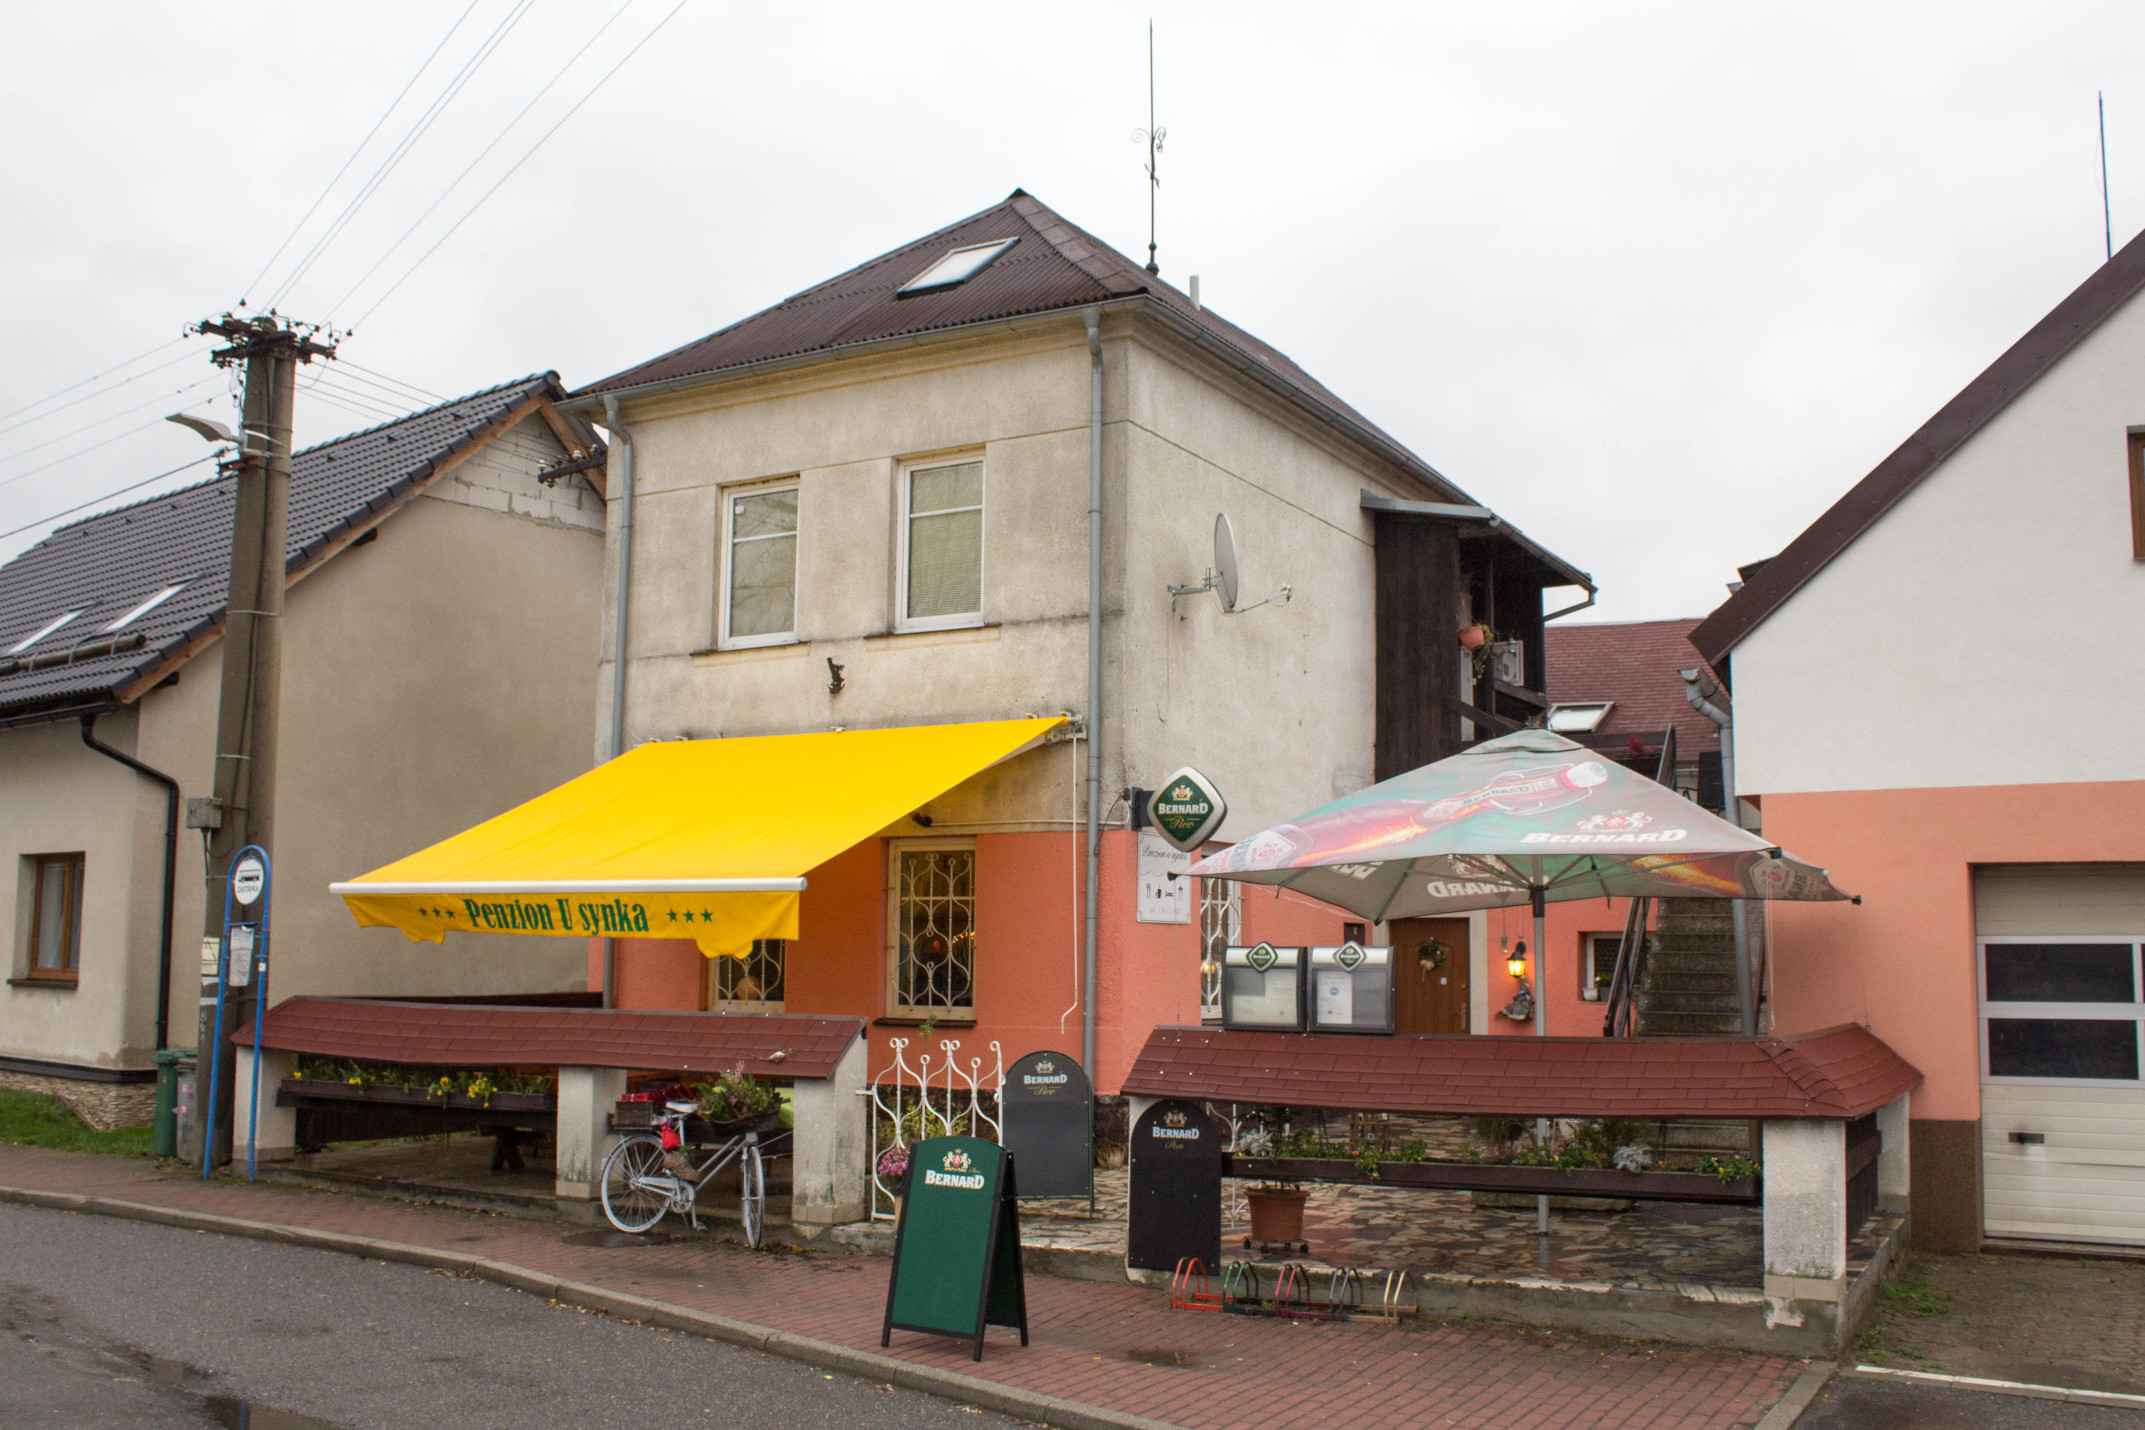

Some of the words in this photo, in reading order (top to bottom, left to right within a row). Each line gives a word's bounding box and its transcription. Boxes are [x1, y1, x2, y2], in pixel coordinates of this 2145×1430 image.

[1158, 802, 1209, 815] BERNARD
[1520, 829, 1688, 844] BERNARD
[462, 898, 555, 930] Penzion
[556, 898, 573, 931] U
[578, 898, 650, 936] synka
[1023, 1074, 1068, 1085] BERNARD
[1152, 1126, 1200, 1139] BERNARD
[924, 1169, 985, 1190] BERNARD
